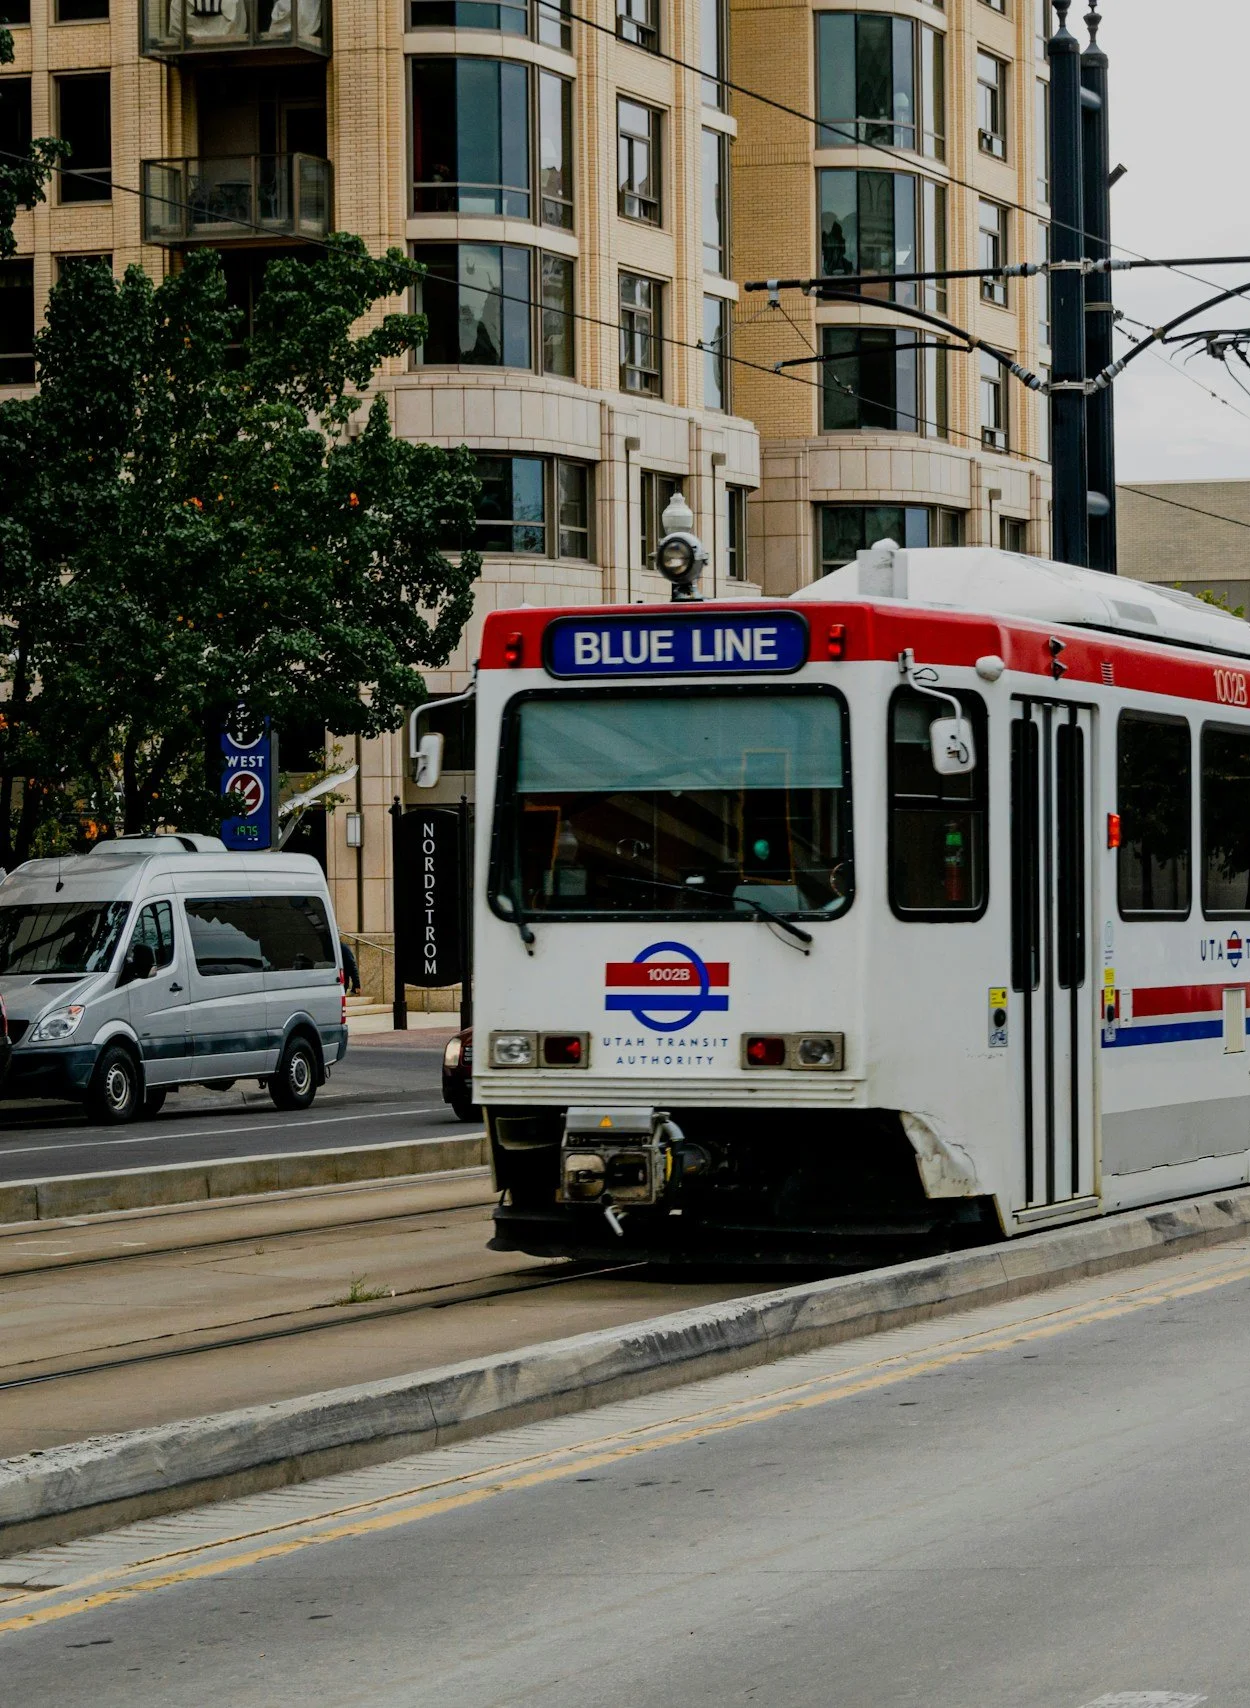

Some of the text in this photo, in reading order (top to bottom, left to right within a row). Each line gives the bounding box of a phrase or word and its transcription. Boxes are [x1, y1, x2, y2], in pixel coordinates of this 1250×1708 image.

[573, 626, 779, 665] BLUE LINE
[1212, 668, 1249, 706] 1002B
[225, 755, 265, 768] WEST
[422, 822, 437, 974] NORDSTROM
[1200, 938, 1224, 961] UTA
[647, 968, 691, 981] 1002B
[602, 1037, 729, 1047] UTAH TRANSIT
[616, 1056, 714, 1065] AUTHORITY
